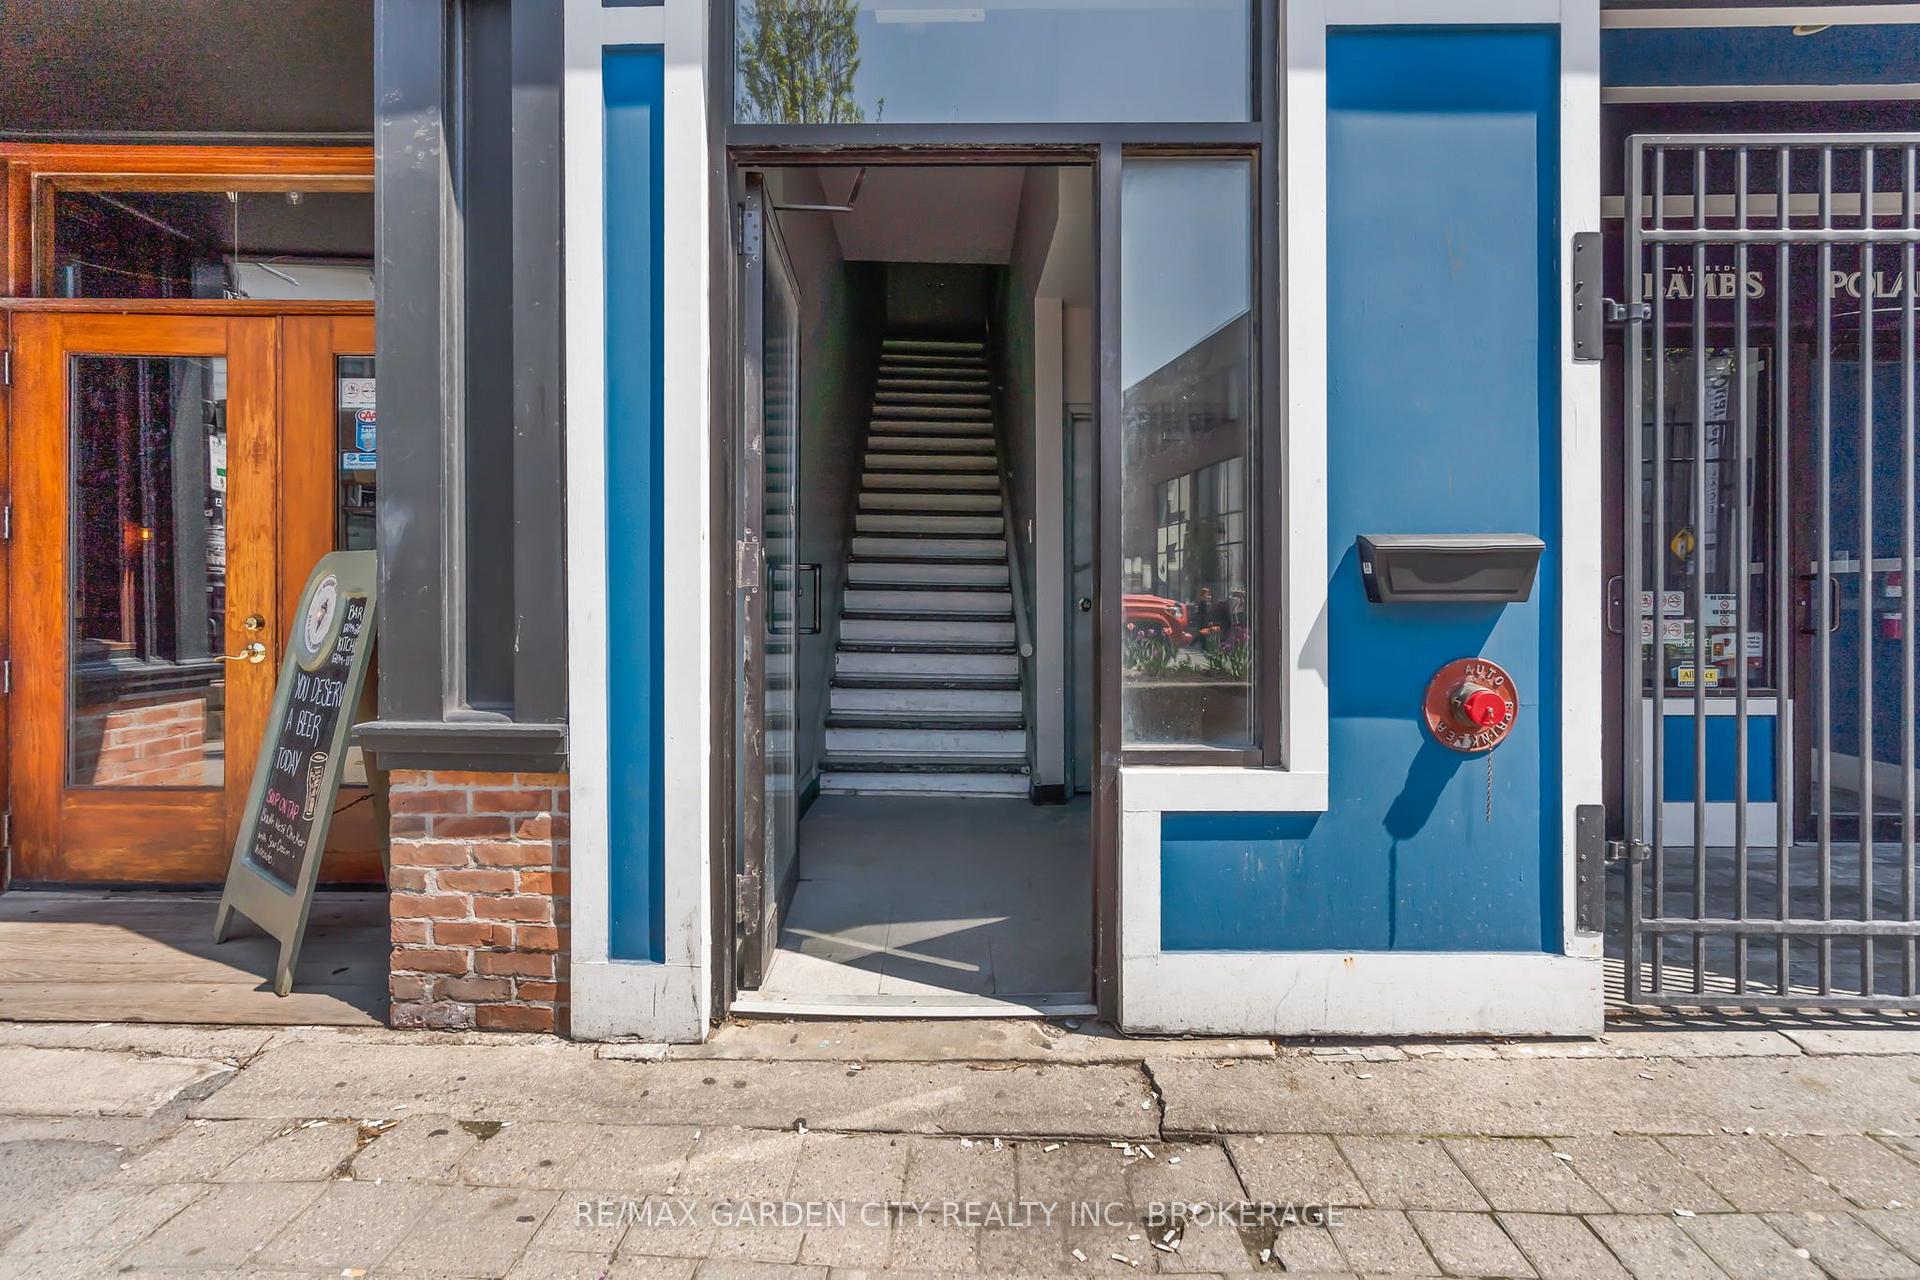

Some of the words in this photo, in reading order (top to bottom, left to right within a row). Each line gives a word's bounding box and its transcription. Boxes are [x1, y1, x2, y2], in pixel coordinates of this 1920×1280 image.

[347, 604, 364, 622] BAR
[294, 672, 311, 702] YOU
[1465, 664, 1504, 686] AUTO
[285, 708, 294, 734] A
[296, 710, 322, 749] BEER
[276, 747, 303, 778] TODAY
[287, 800, 300, 821] TAP
